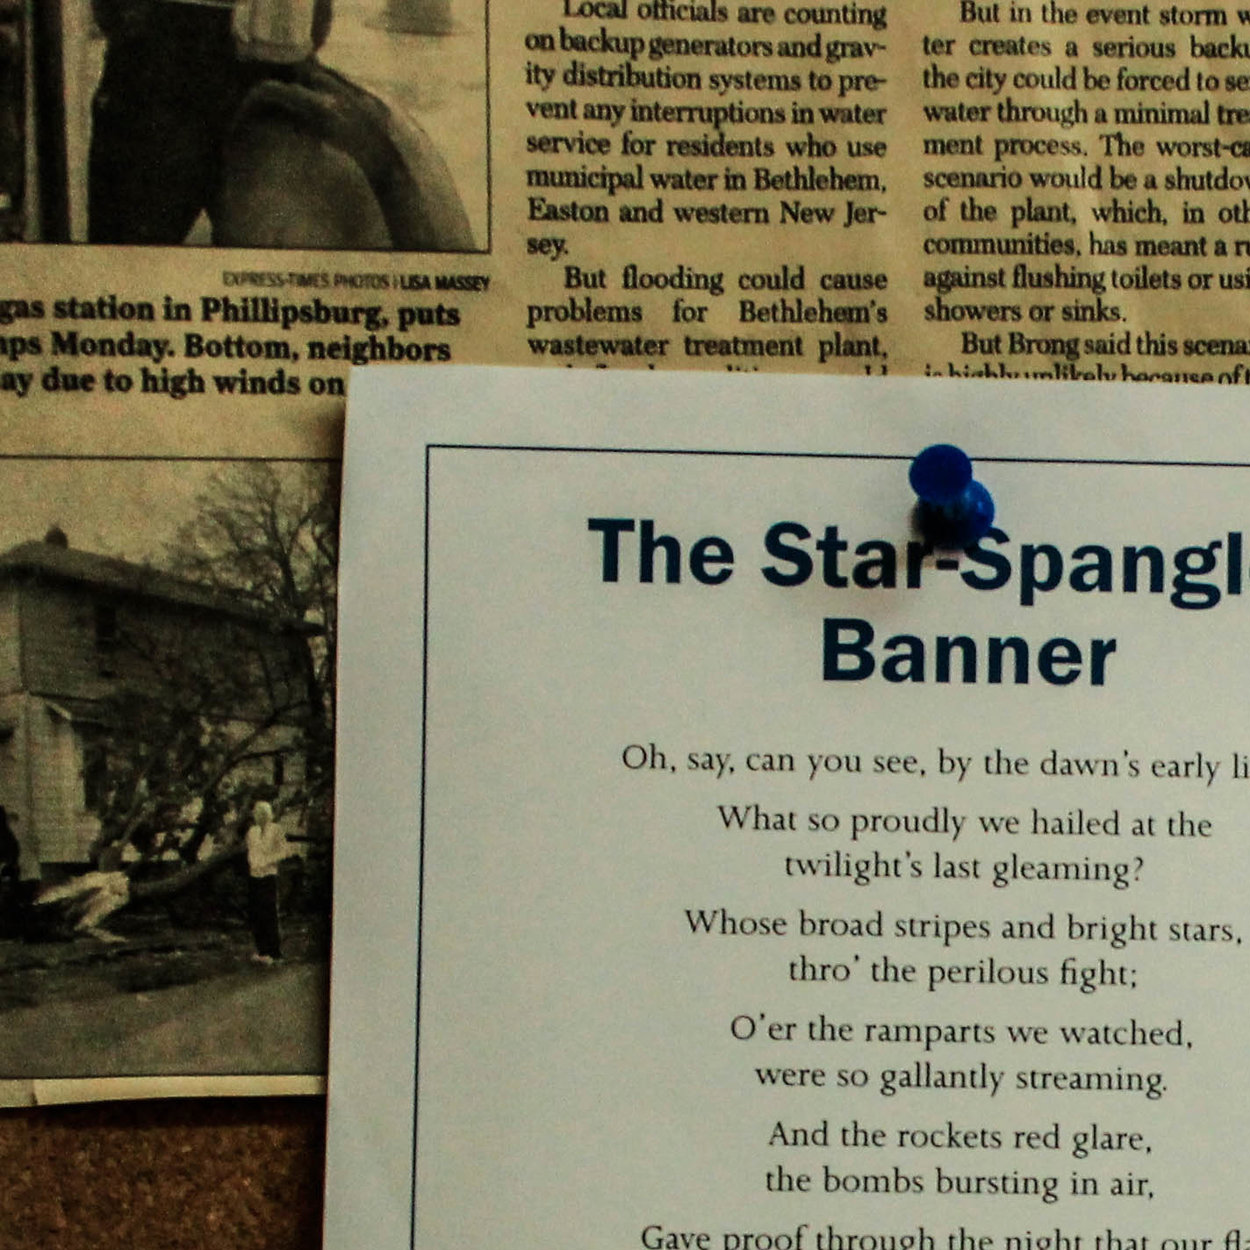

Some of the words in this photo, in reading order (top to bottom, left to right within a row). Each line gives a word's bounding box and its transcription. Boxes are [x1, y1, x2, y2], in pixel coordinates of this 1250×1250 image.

[960, 0, 1000, 25] But
[1009, 5, 1032, 24] in
[1041, 1, 1078, 26] the
[1085, 5, 1150, 26] event
[1159, 5, 1228, 27] storm
[524, 33, 556, 53] on
[559, 28, 646, 61] backup
[648, 35, 774, 61] generators
[776, 33, 823, 60] and
[825, 39, 887, 64] grav-
[400, 275, 431, 291] LISA
[435, 275, 491, 293] MASSEY
[53, 294, 156, 323] station
[162, 295, 193, 323] in
[200, 296, 390, 333] Phillipsburg,
[397, 302, 461, 334] puts
[51, 331, 176, 365] Monday.
[184, 333, 300, 363] Bottom,
[306, 335, 453, 366] neighbors
[41, 366, 96, 394] due
[102, 368, 134, 394] to
[139, 367, 206, 402] high
[212, 368, 302, 397] winds
[308, 375, 347, 397] on
[587, 517, 735, 587] The
[822, 617, 1117, 687] Banner
[622, 742, 676, 774] Oh,
[687, 752, 735, 780] say,
[745, 753, 795, 773] can
[807, 754, 862, 781] you
[873, 755, 926, 777] see,
[938, 747, 972, 783] by
[984, 747, 1029, 776] the
[1040, 748, 1140, 778] dawn's
[1151, 751, 1220, 787] early
[685, 906, 788, 937] Whose
[799, 908, 883, 938] broad
[894, 917, 991, 948] stripes
[1001, 911, 1055, 940] and
[1067, 912, 1158, 950] bright
[1169, 921, 1242, 945] stars,
